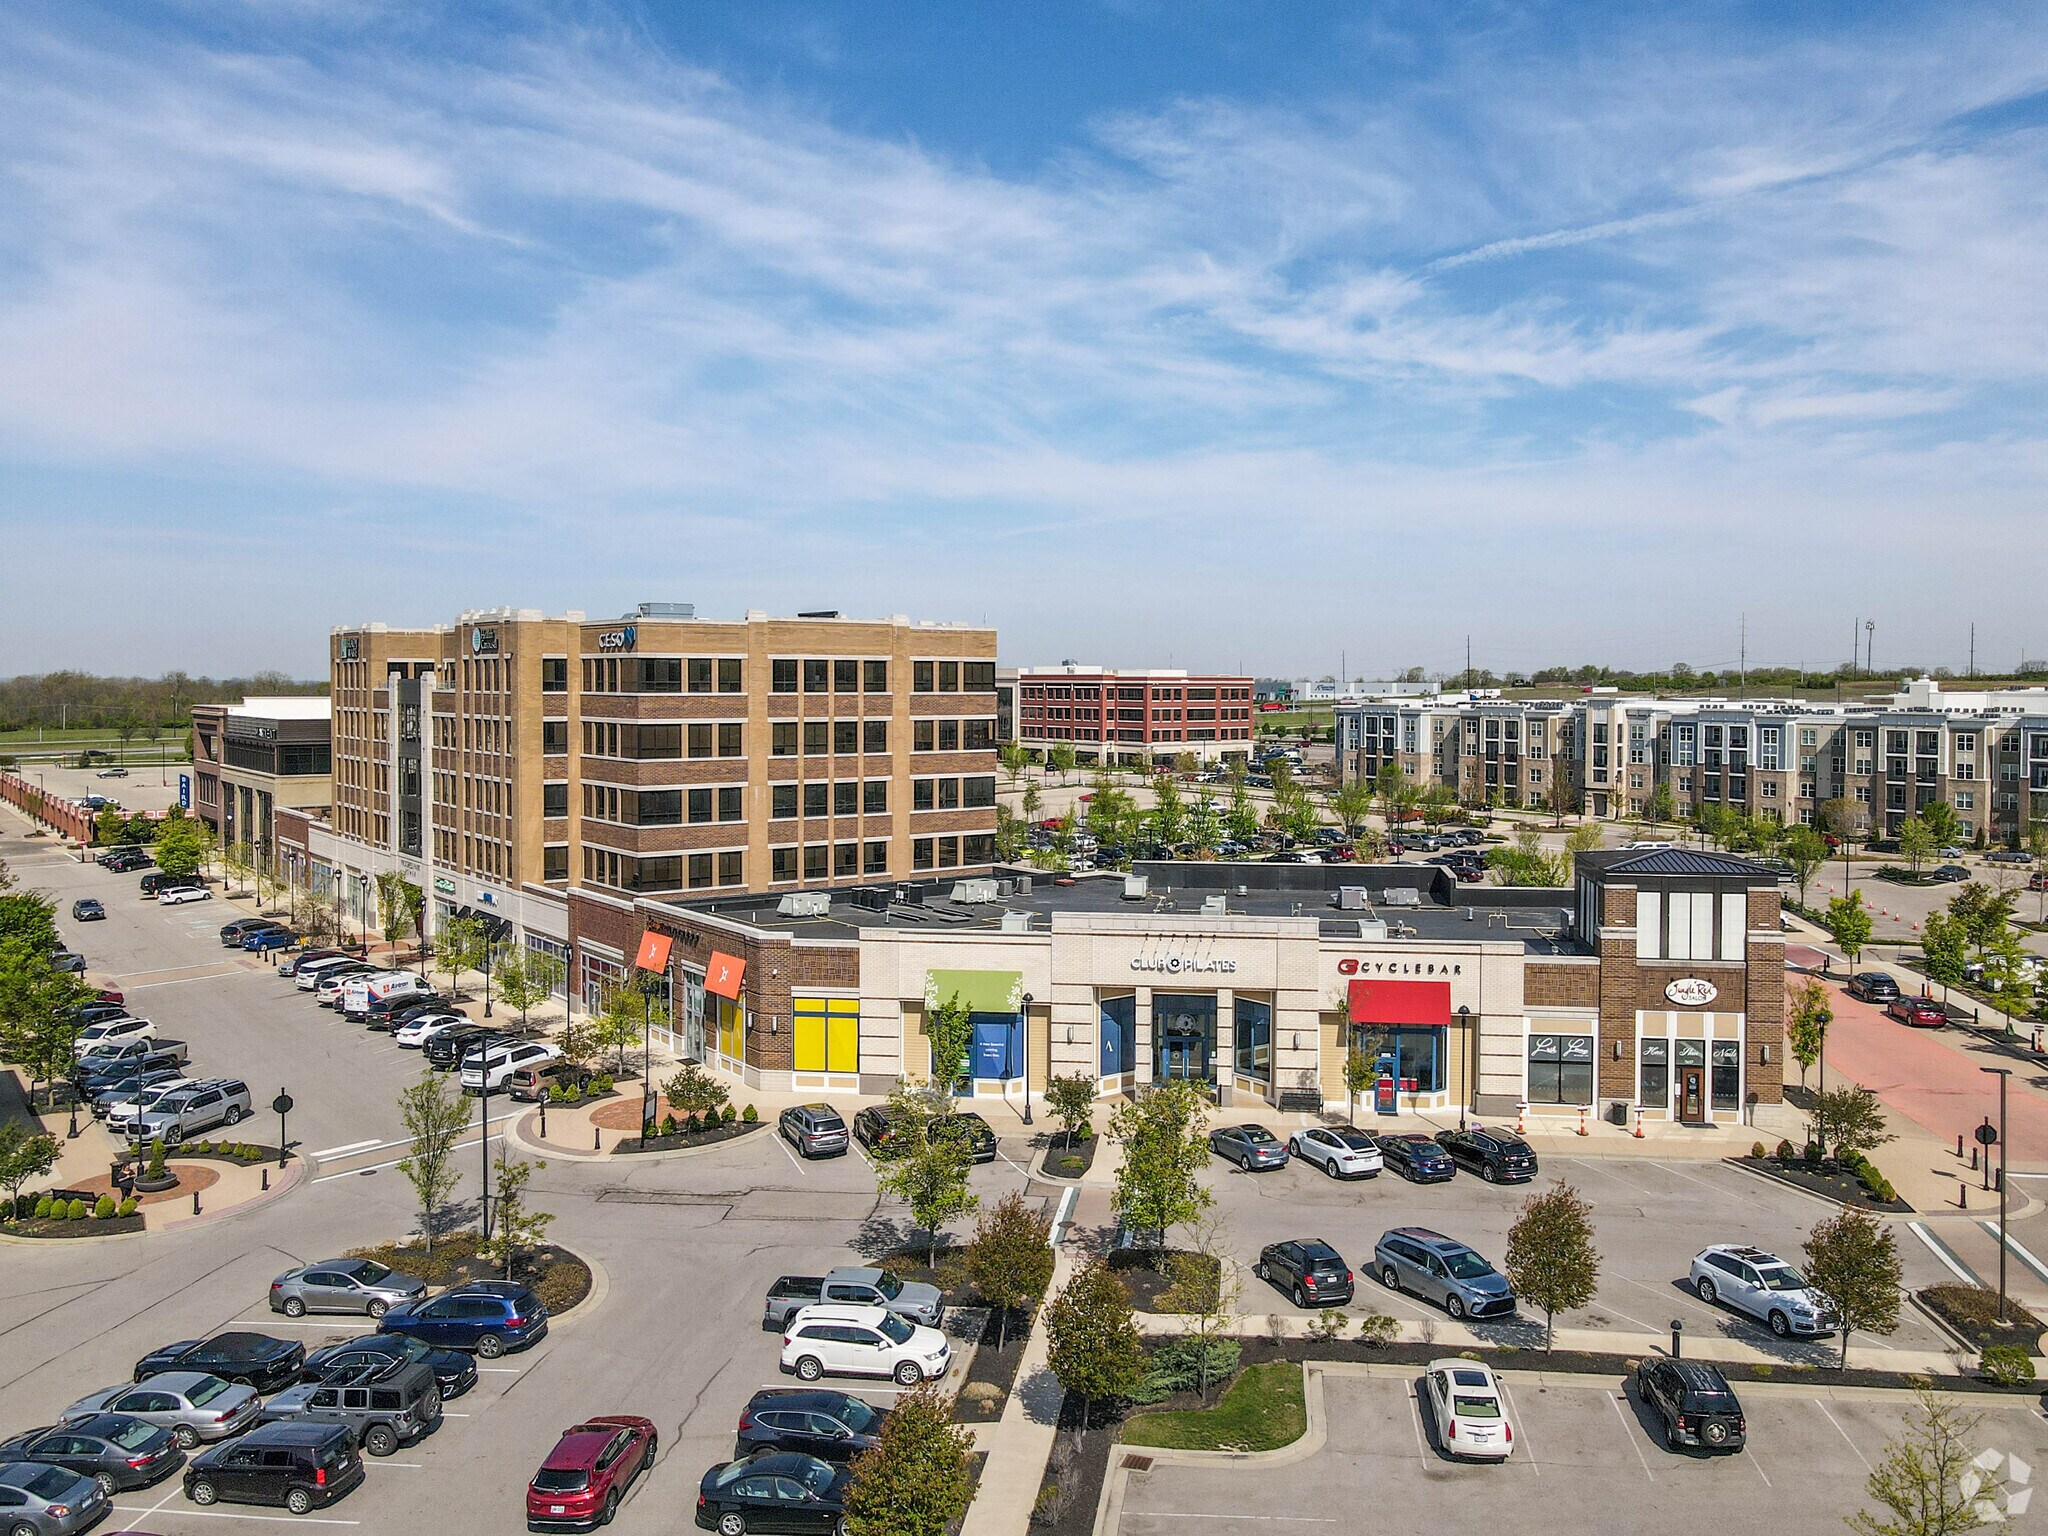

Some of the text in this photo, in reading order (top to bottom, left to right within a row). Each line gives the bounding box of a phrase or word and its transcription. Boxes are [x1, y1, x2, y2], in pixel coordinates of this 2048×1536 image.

[599, 633, 624, 648] CESO
[1184, 958, 1237, 972] PILATES
[1361, 962, 1461, 975] CYCLEBAR
[1668, 983, 1695, 1001] Jungle
[1713, 1048, 1737, 1057] Nails
